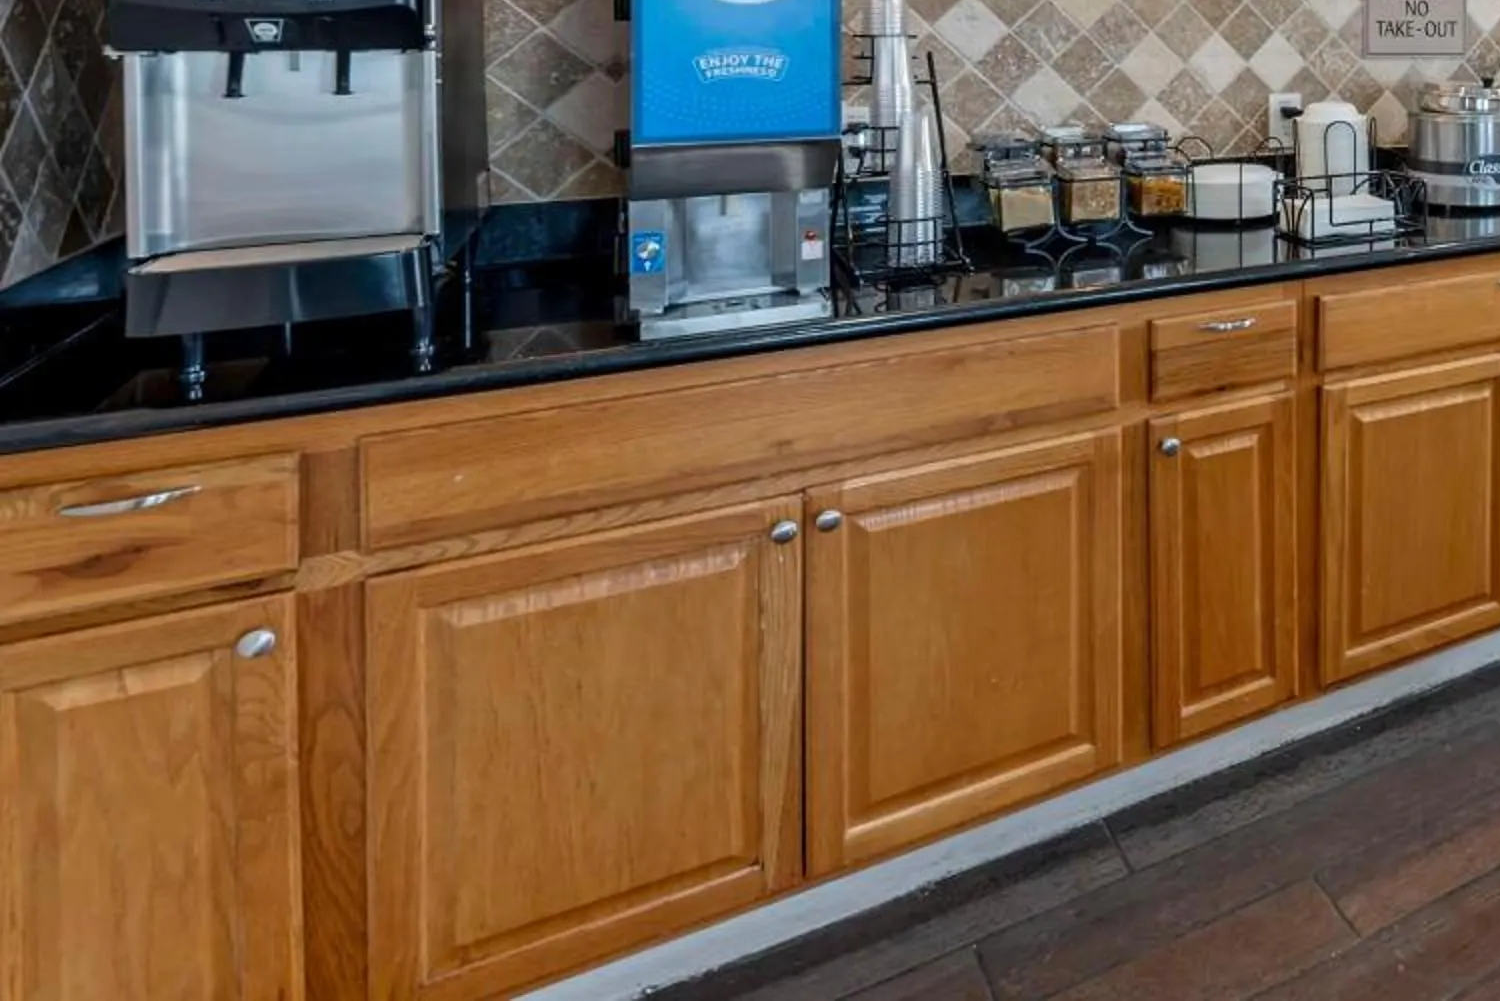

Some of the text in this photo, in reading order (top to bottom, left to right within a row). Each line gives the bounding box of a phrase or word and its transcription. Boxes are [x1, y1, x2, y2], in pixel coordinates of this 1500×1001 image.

[1404, 0, 1430, 17] NO
[1375, 20, 1458, 39] TAKE-OUT
[699, 53, 785, 69] ENJOY THE
